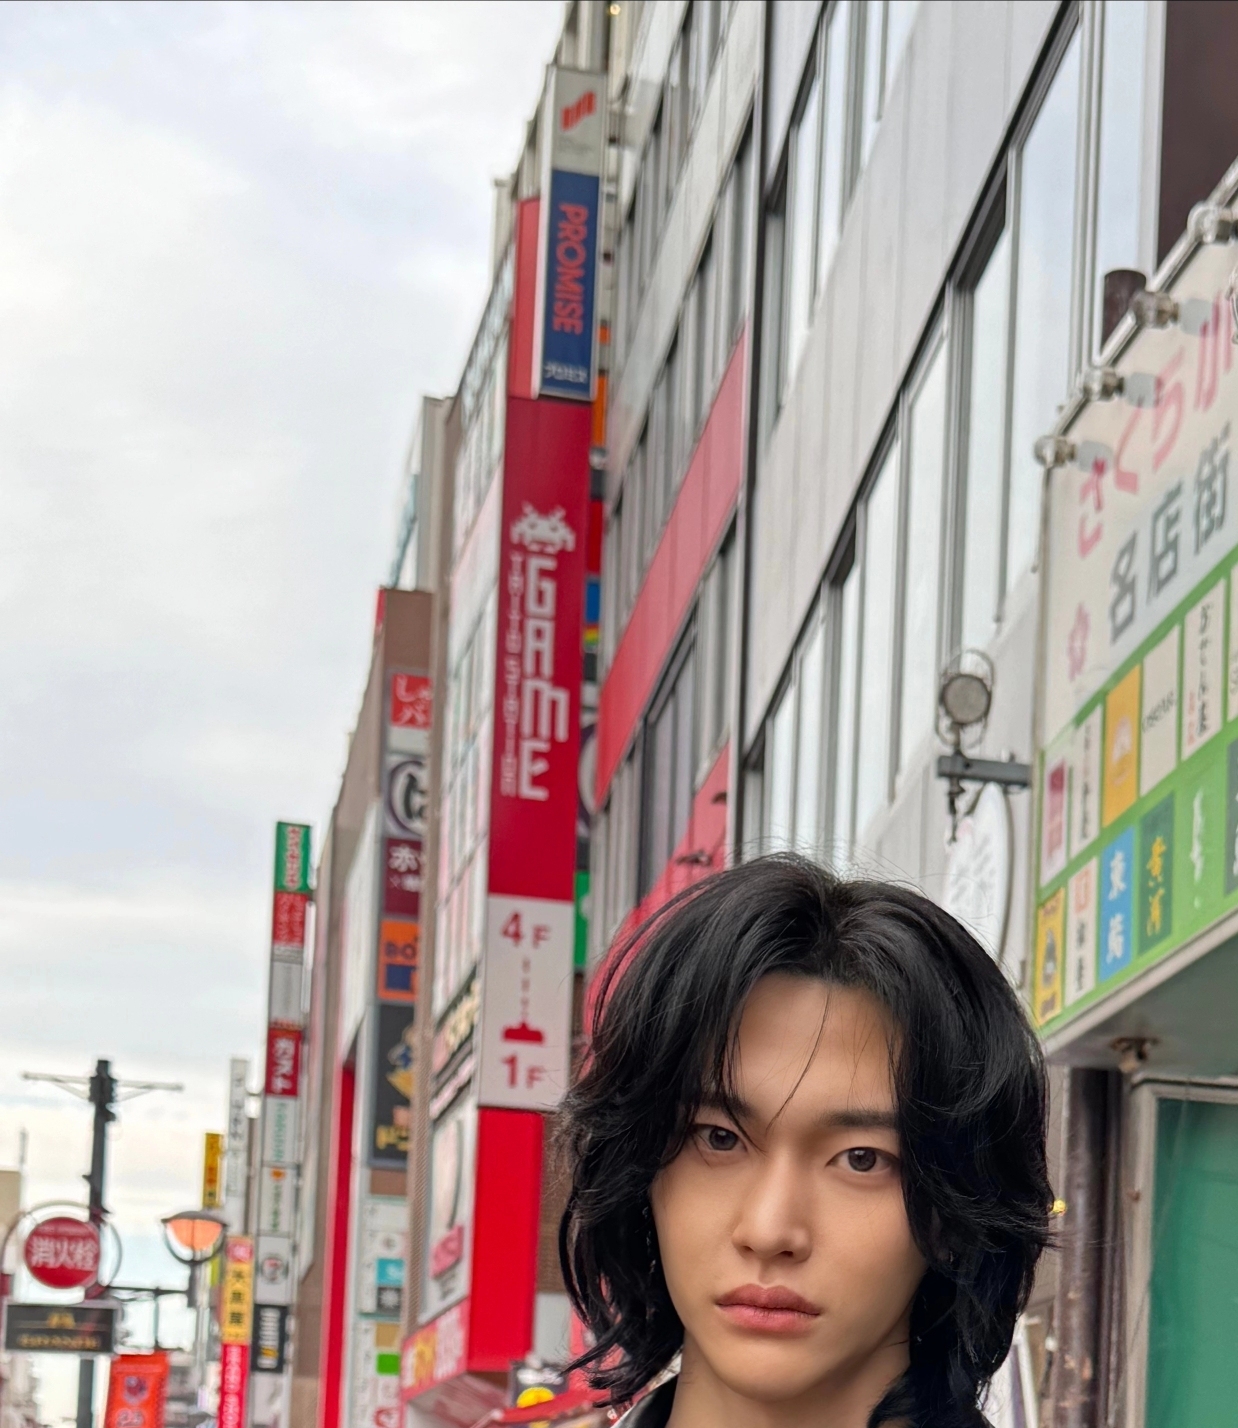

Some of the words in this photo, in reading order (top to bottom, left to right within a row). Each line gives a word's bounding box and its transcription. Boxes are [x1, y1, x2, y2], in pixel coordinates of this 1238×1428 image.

[552, 202, 588, 335] PROMISE
[1111, 418, 1232, 643] 名店街
[517, 556, 570, 801] GAME
[501, 911, 550, 949] 4F
[500, 1054, 546, 1089] 1F
[31, 1235, 98, 1270] 消火栓
